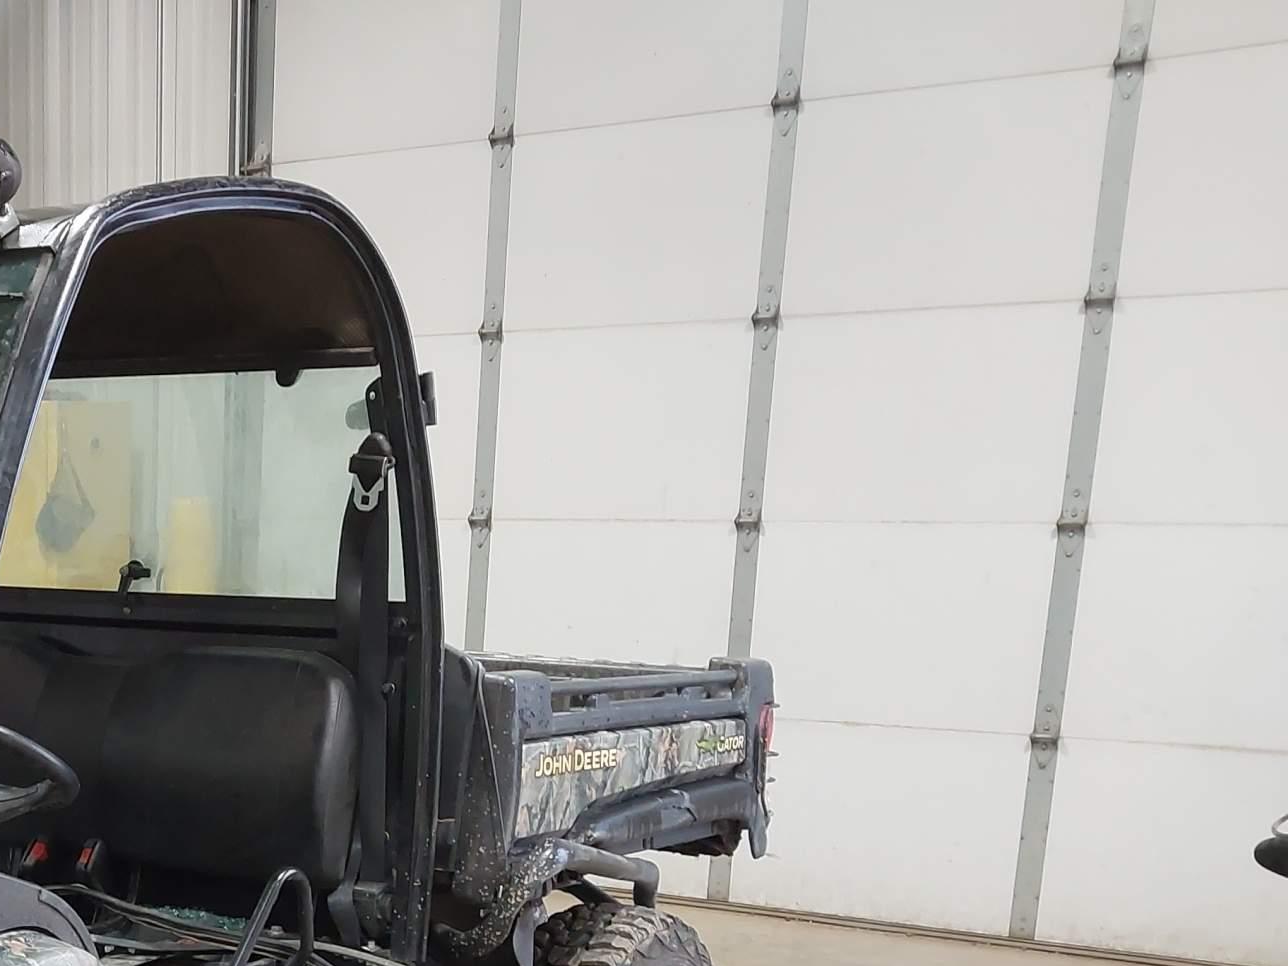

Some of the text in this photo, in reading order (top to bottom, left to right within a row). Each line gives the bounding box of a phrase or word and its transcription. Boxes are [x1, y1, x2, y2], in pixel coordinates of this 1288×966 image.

[717, 735, 745, 751] GATOR
[535, 748, 617, 777] JOHN DEERE
